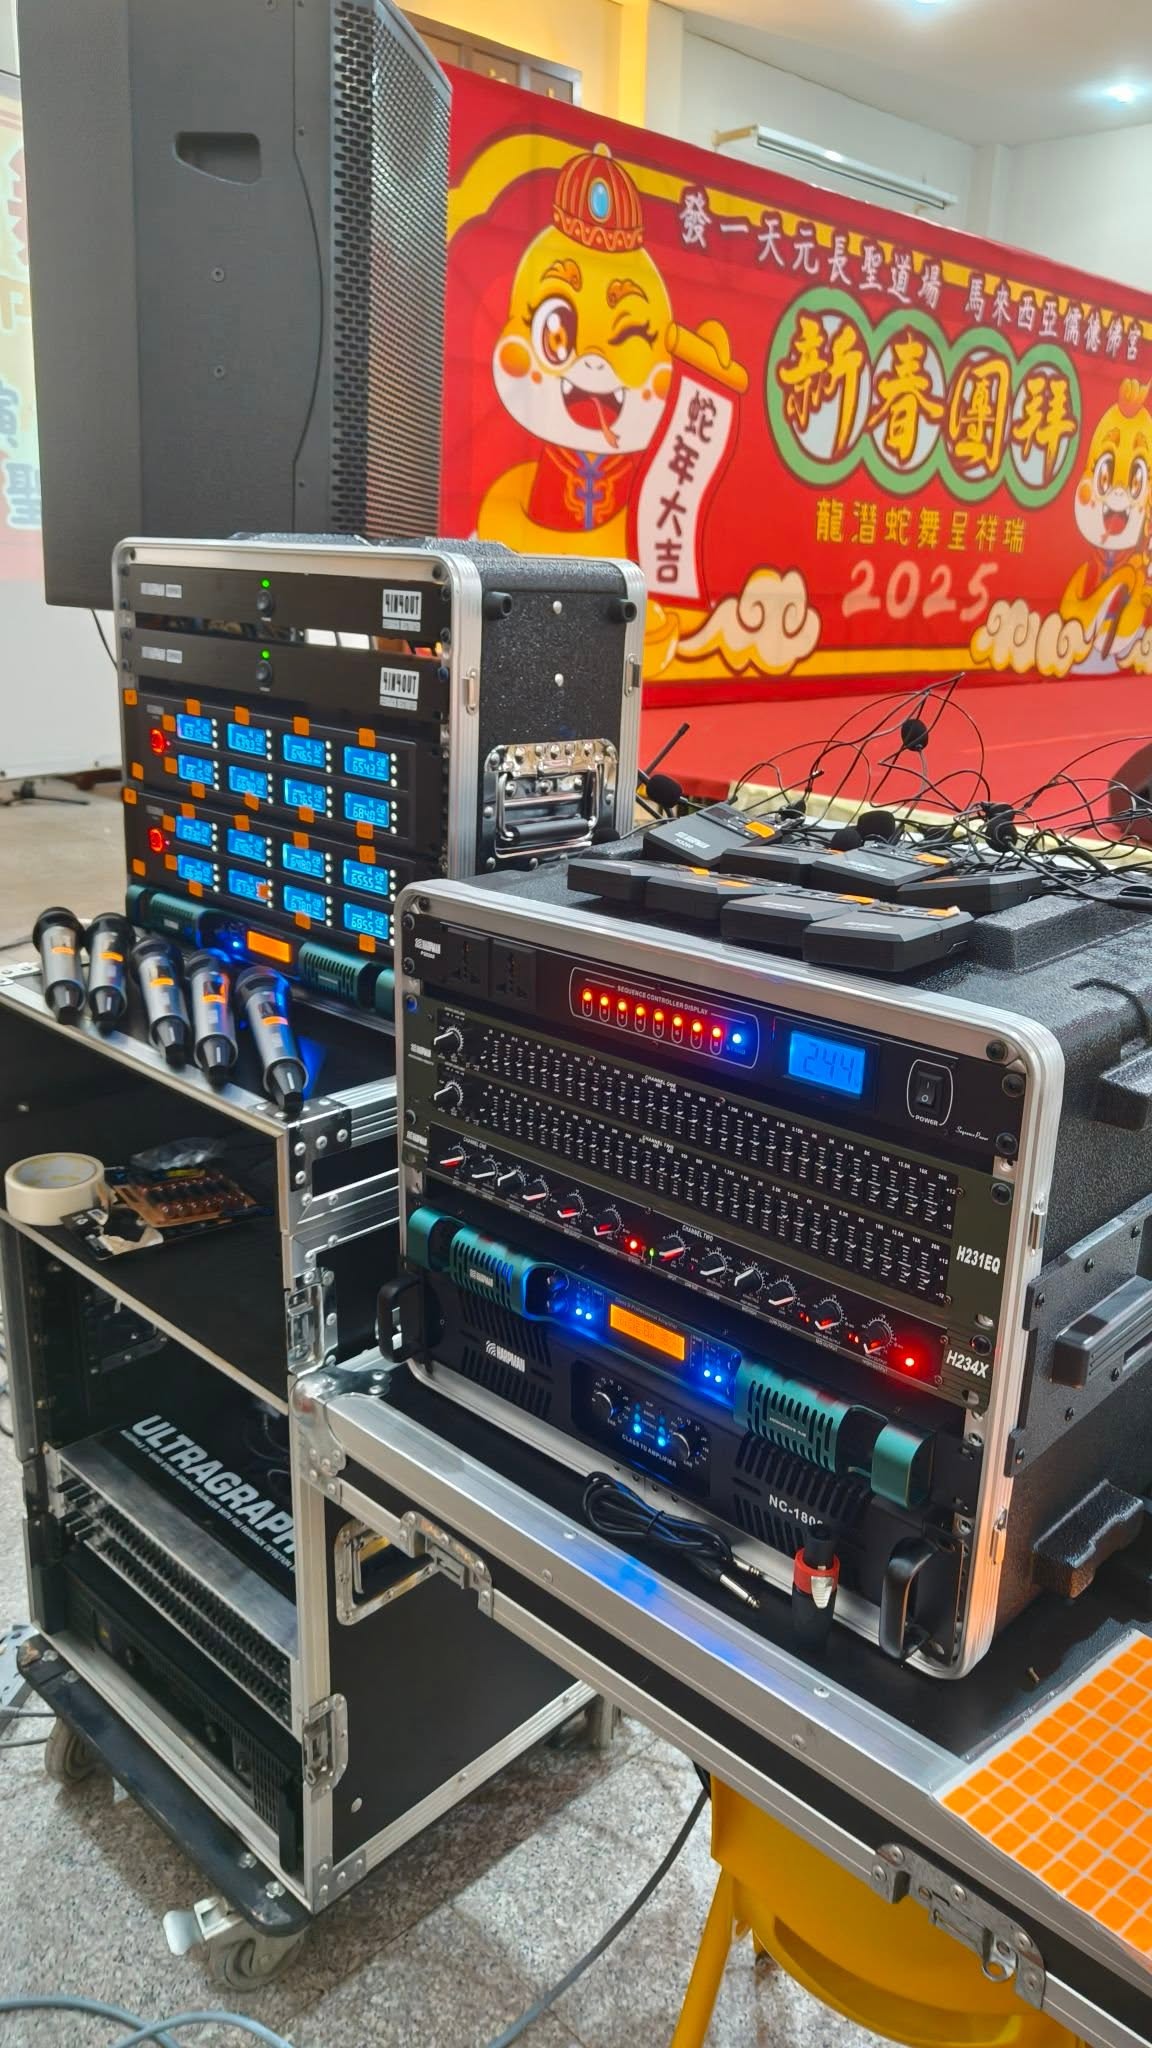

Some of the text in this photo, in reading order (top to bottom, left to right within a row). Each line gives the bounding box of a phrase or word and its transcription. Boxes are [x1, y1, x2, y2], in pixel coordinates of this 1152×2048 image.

[679, 191, 942, 310] 發一天元長聖道場
[778, 315, 1078, 483] 新春團拜
[655, 390, 717, 584] 蛇年大吉
[816, 498, 1025, 553] 龍潛蛇舞呈祥瑞
[842, 559, 999, 622] 2025
[617, 984, 647, 999] SEQUENCE
[646, 992, 684, 1010] CONTROLLER
[802, 1041, 856, 1084] 244
[915, 1114, 939, 1126] POWER
[682, 1225, 714, 1242] CHANNEL TWO
[956, 1244, 1001, 1275] H231EQ
[945, 1350, 989, 1379] H234X
